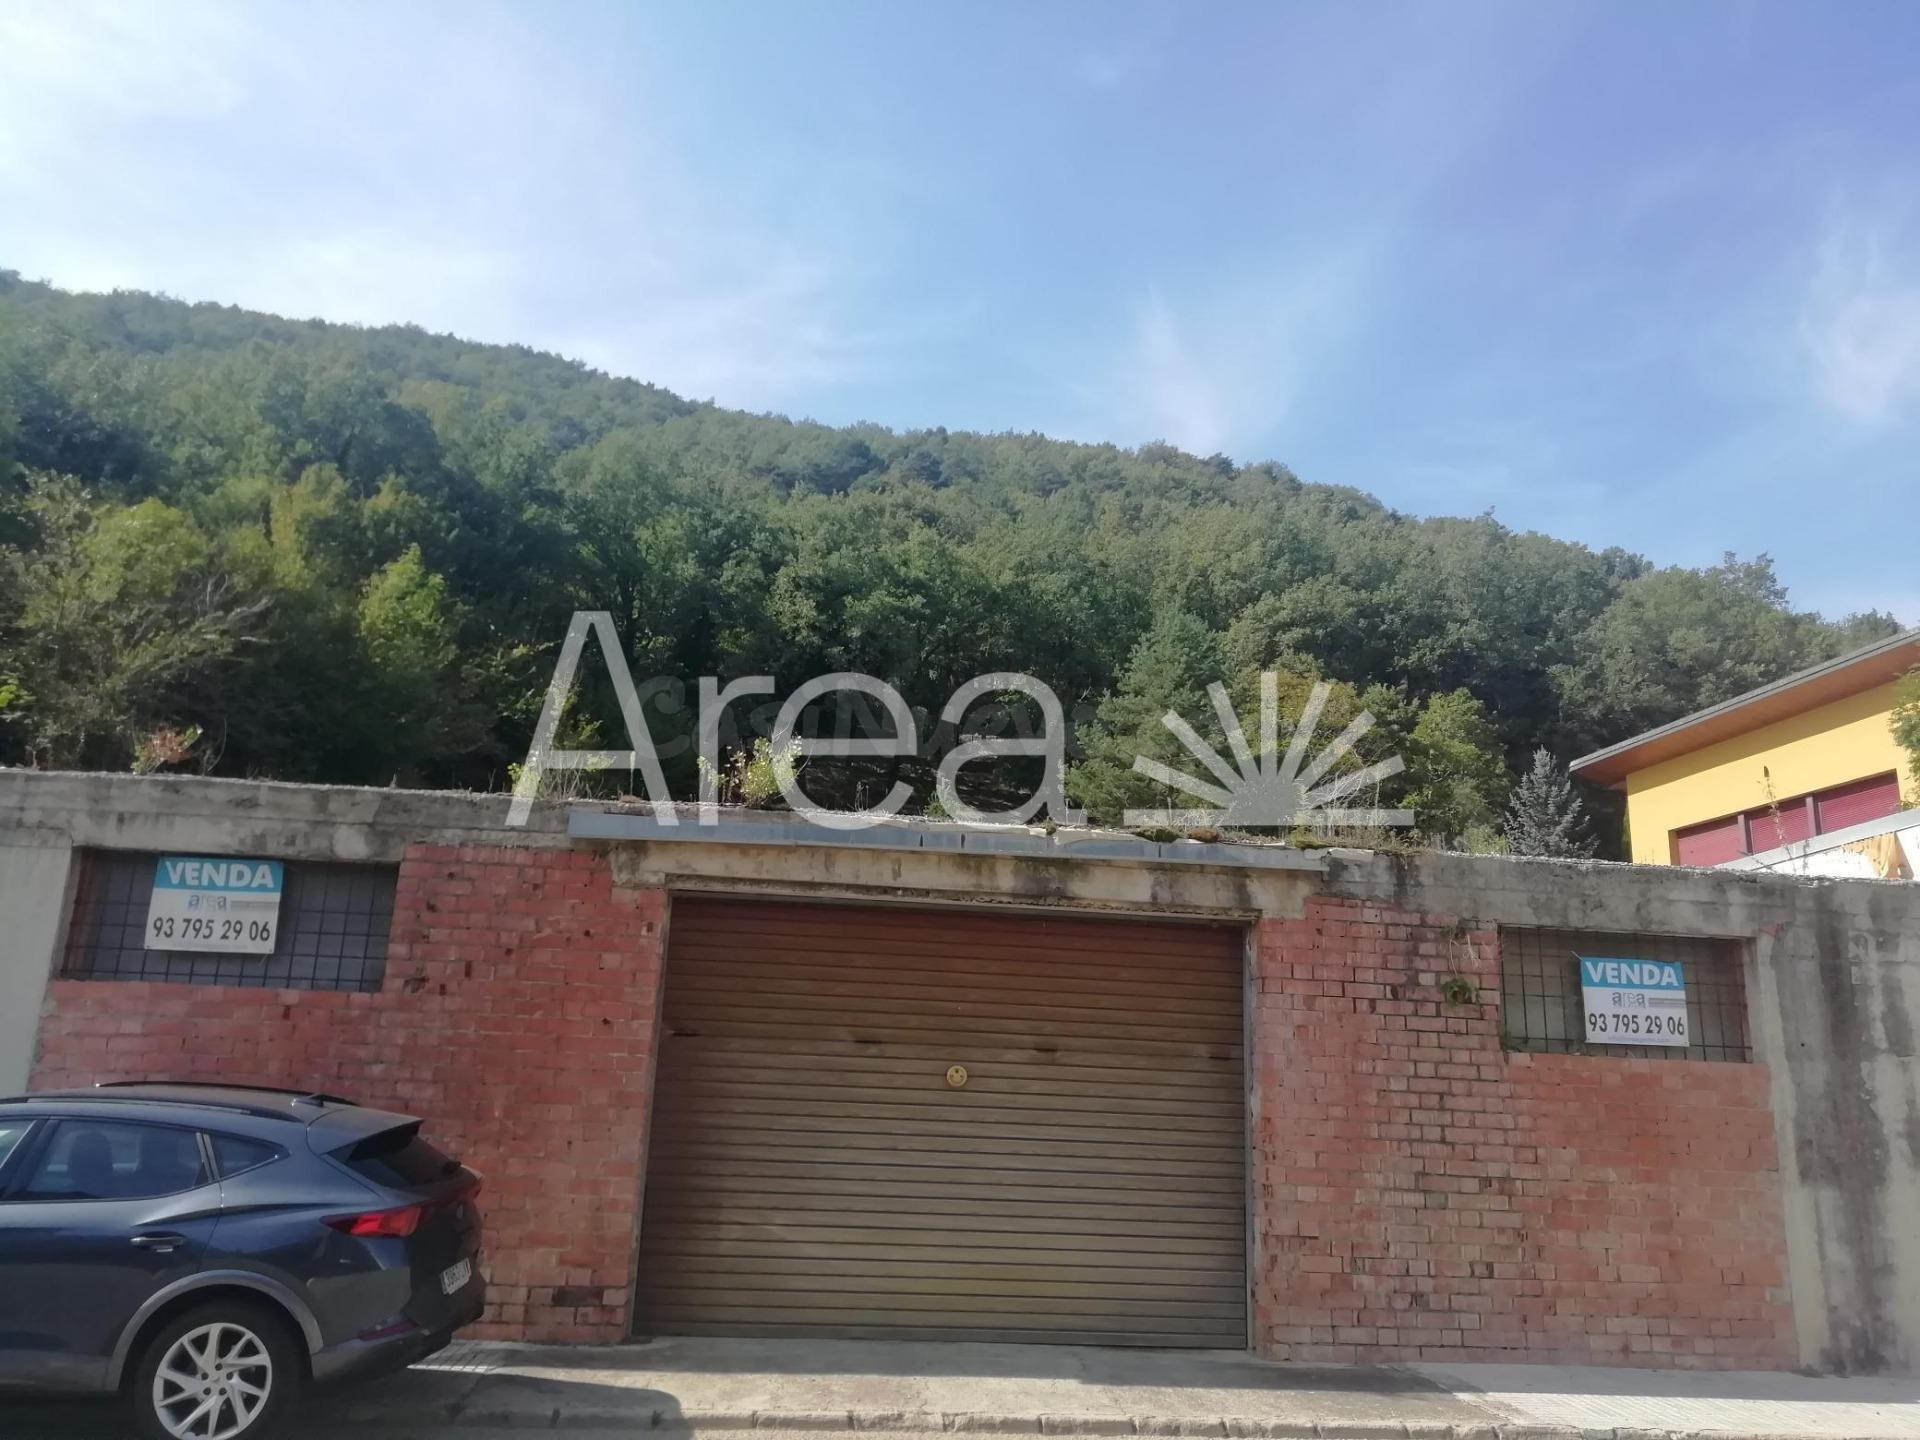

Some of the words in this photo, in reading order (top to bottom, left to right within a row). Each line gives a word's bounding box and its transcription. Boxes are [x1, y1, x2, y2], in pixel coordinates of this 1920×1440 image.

[165, 860, 275, 889] VENDA
[153, 916, 175, 938] 93
[181, 918, 215, 940] 795
[220, 919, 244, 940] 29
[249, 920, 271, 942] 06
[1585, 961, 1680, 987] VENDA
[1588, 1012, 1608, 1033] 93
[1612, 1014, 1640, 1034] 795
[1645, 1015, 1663, 1035] 29
[1667, 1016, 1685, 1036] 06
